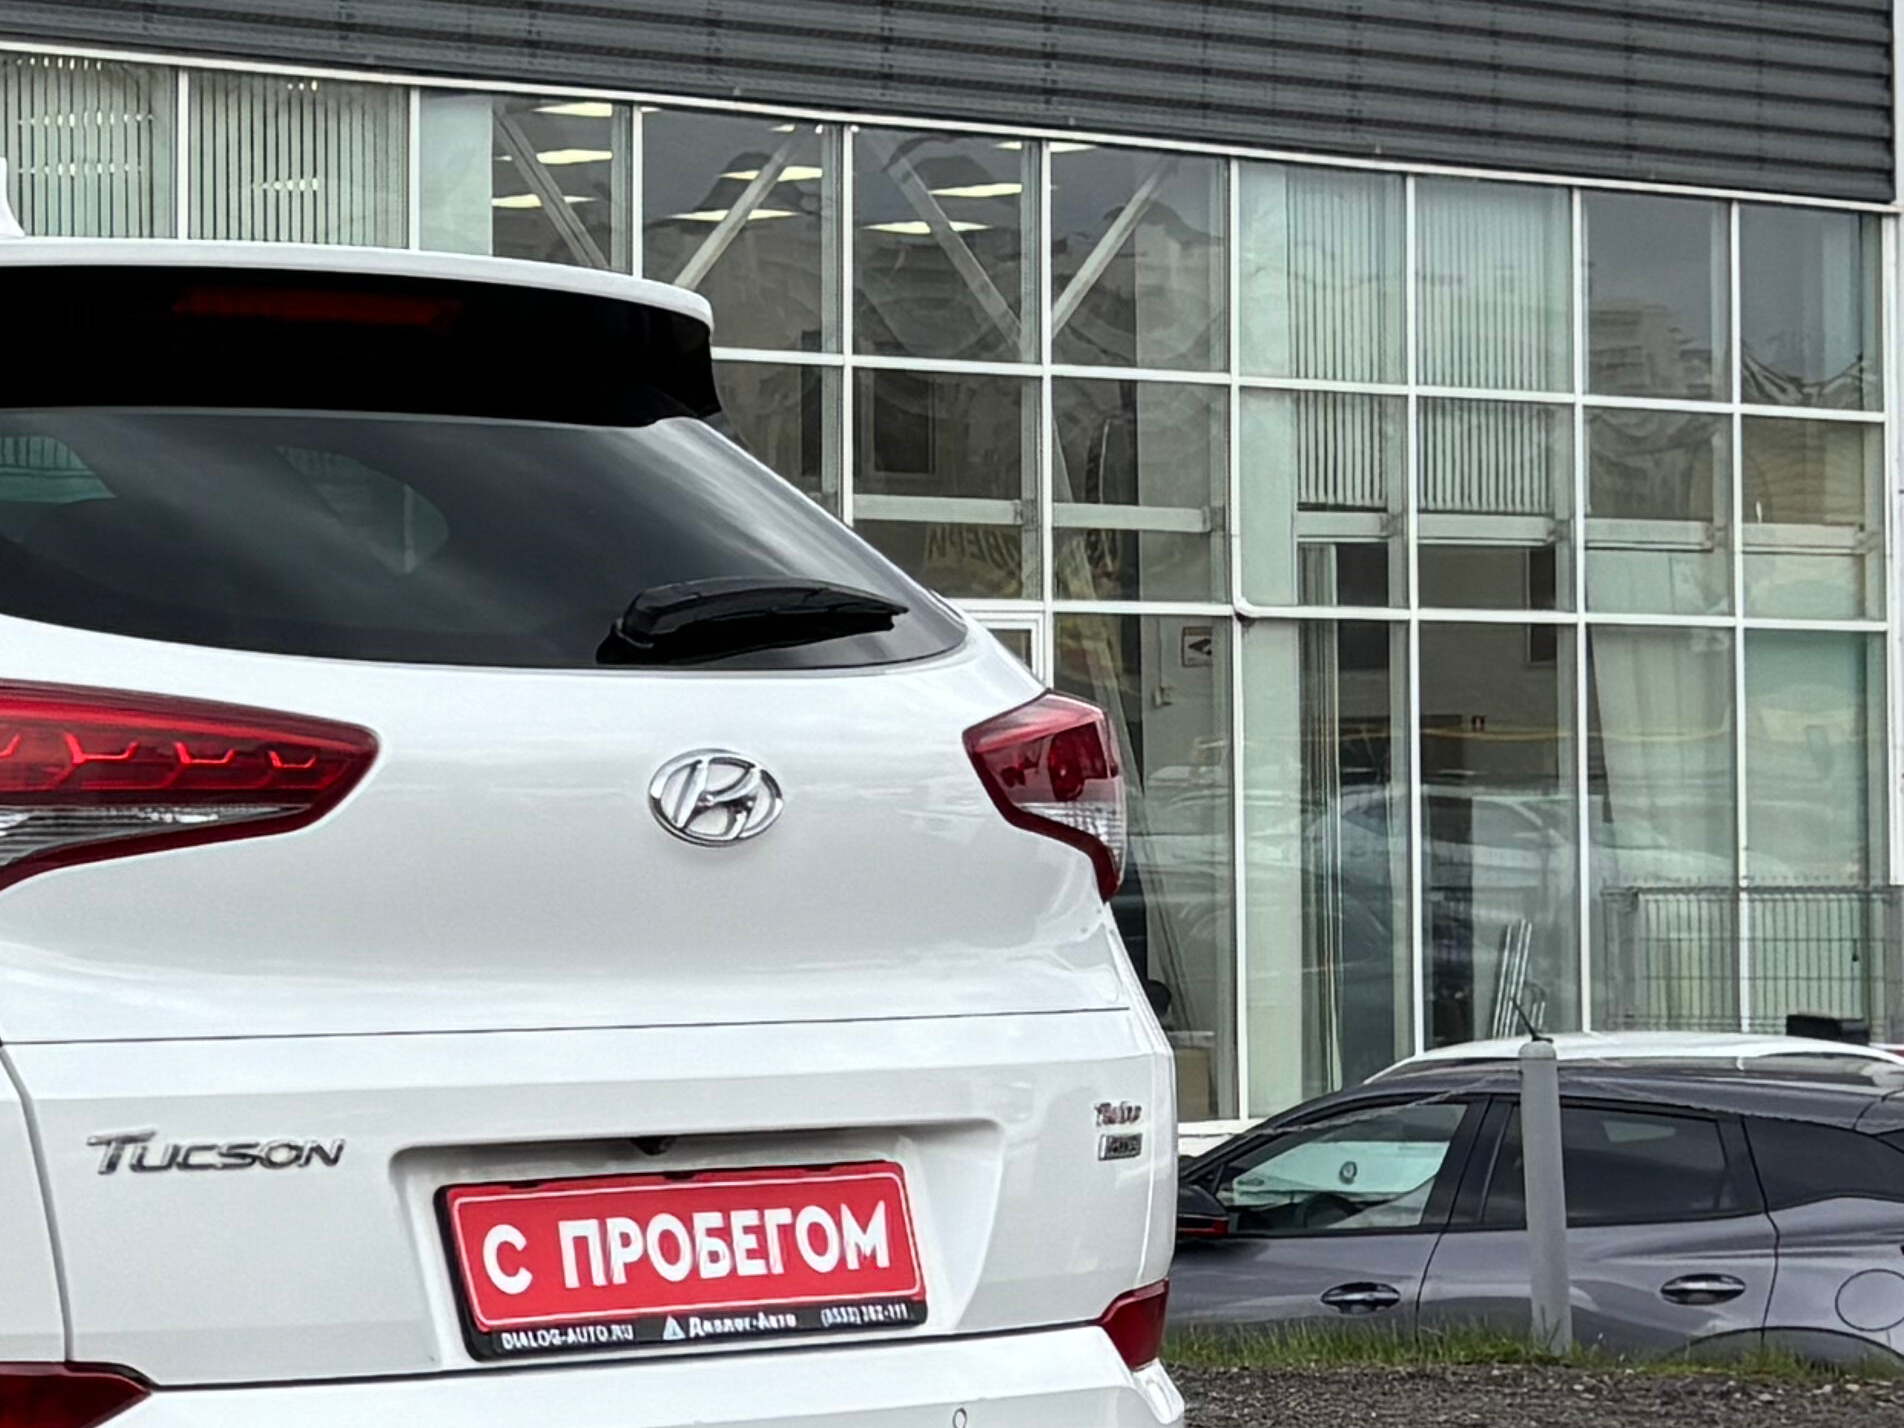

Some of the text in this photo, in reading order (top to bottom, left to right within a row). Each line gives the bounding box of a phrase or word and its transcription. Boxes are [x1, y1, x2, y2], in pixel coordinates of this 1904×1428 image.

[86, 1124, 346, 1175] TUCSON
[482, 1200, 891, 1295] С ПРОБЕГОМ
[500, 1324, 634, 1350] DIALOG-AUTO.RU
